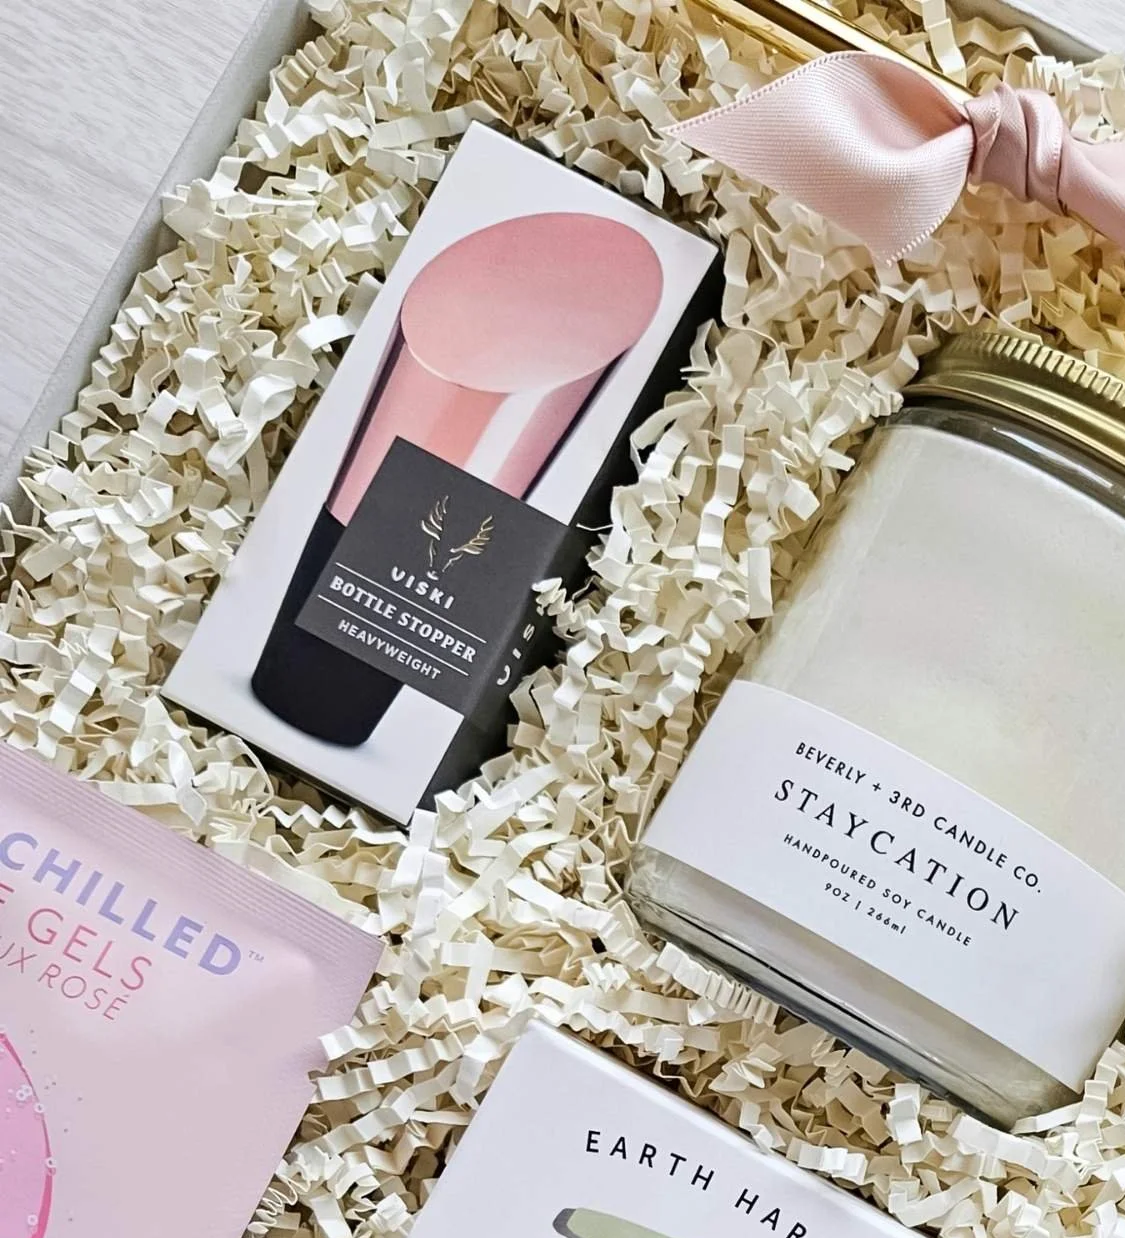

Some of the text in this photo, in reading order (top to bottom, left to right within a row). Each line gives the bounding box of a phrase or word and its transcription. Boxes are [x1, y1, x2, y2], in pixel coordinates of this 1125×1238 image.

[329, 575, 476, 663] BOTTLE STOPPER
[391, 566, 454, 609] VISKI
[338, 619, 441, 680] HEAVYWEIGHT
[795, 742, 866, 784] BEVERLY
[889, 791, 925, 817] 3RD
[934, 817, 1007, 868] CANDLE
[1013, 866, 1041, 893] CO.
[774, 779, 1020, 931] STAYCATION
[784, 833, 971, 946] HANDPOURED SOY CANDLE
[824, 883, 850, 903] 9OZ
[867, 907, 906, 934] 266ml
[27, 908, 152, 991] GELS
[37, 963, 130, 1021] ROSÉ
[586, 1130, 715, 1191] EARTH
